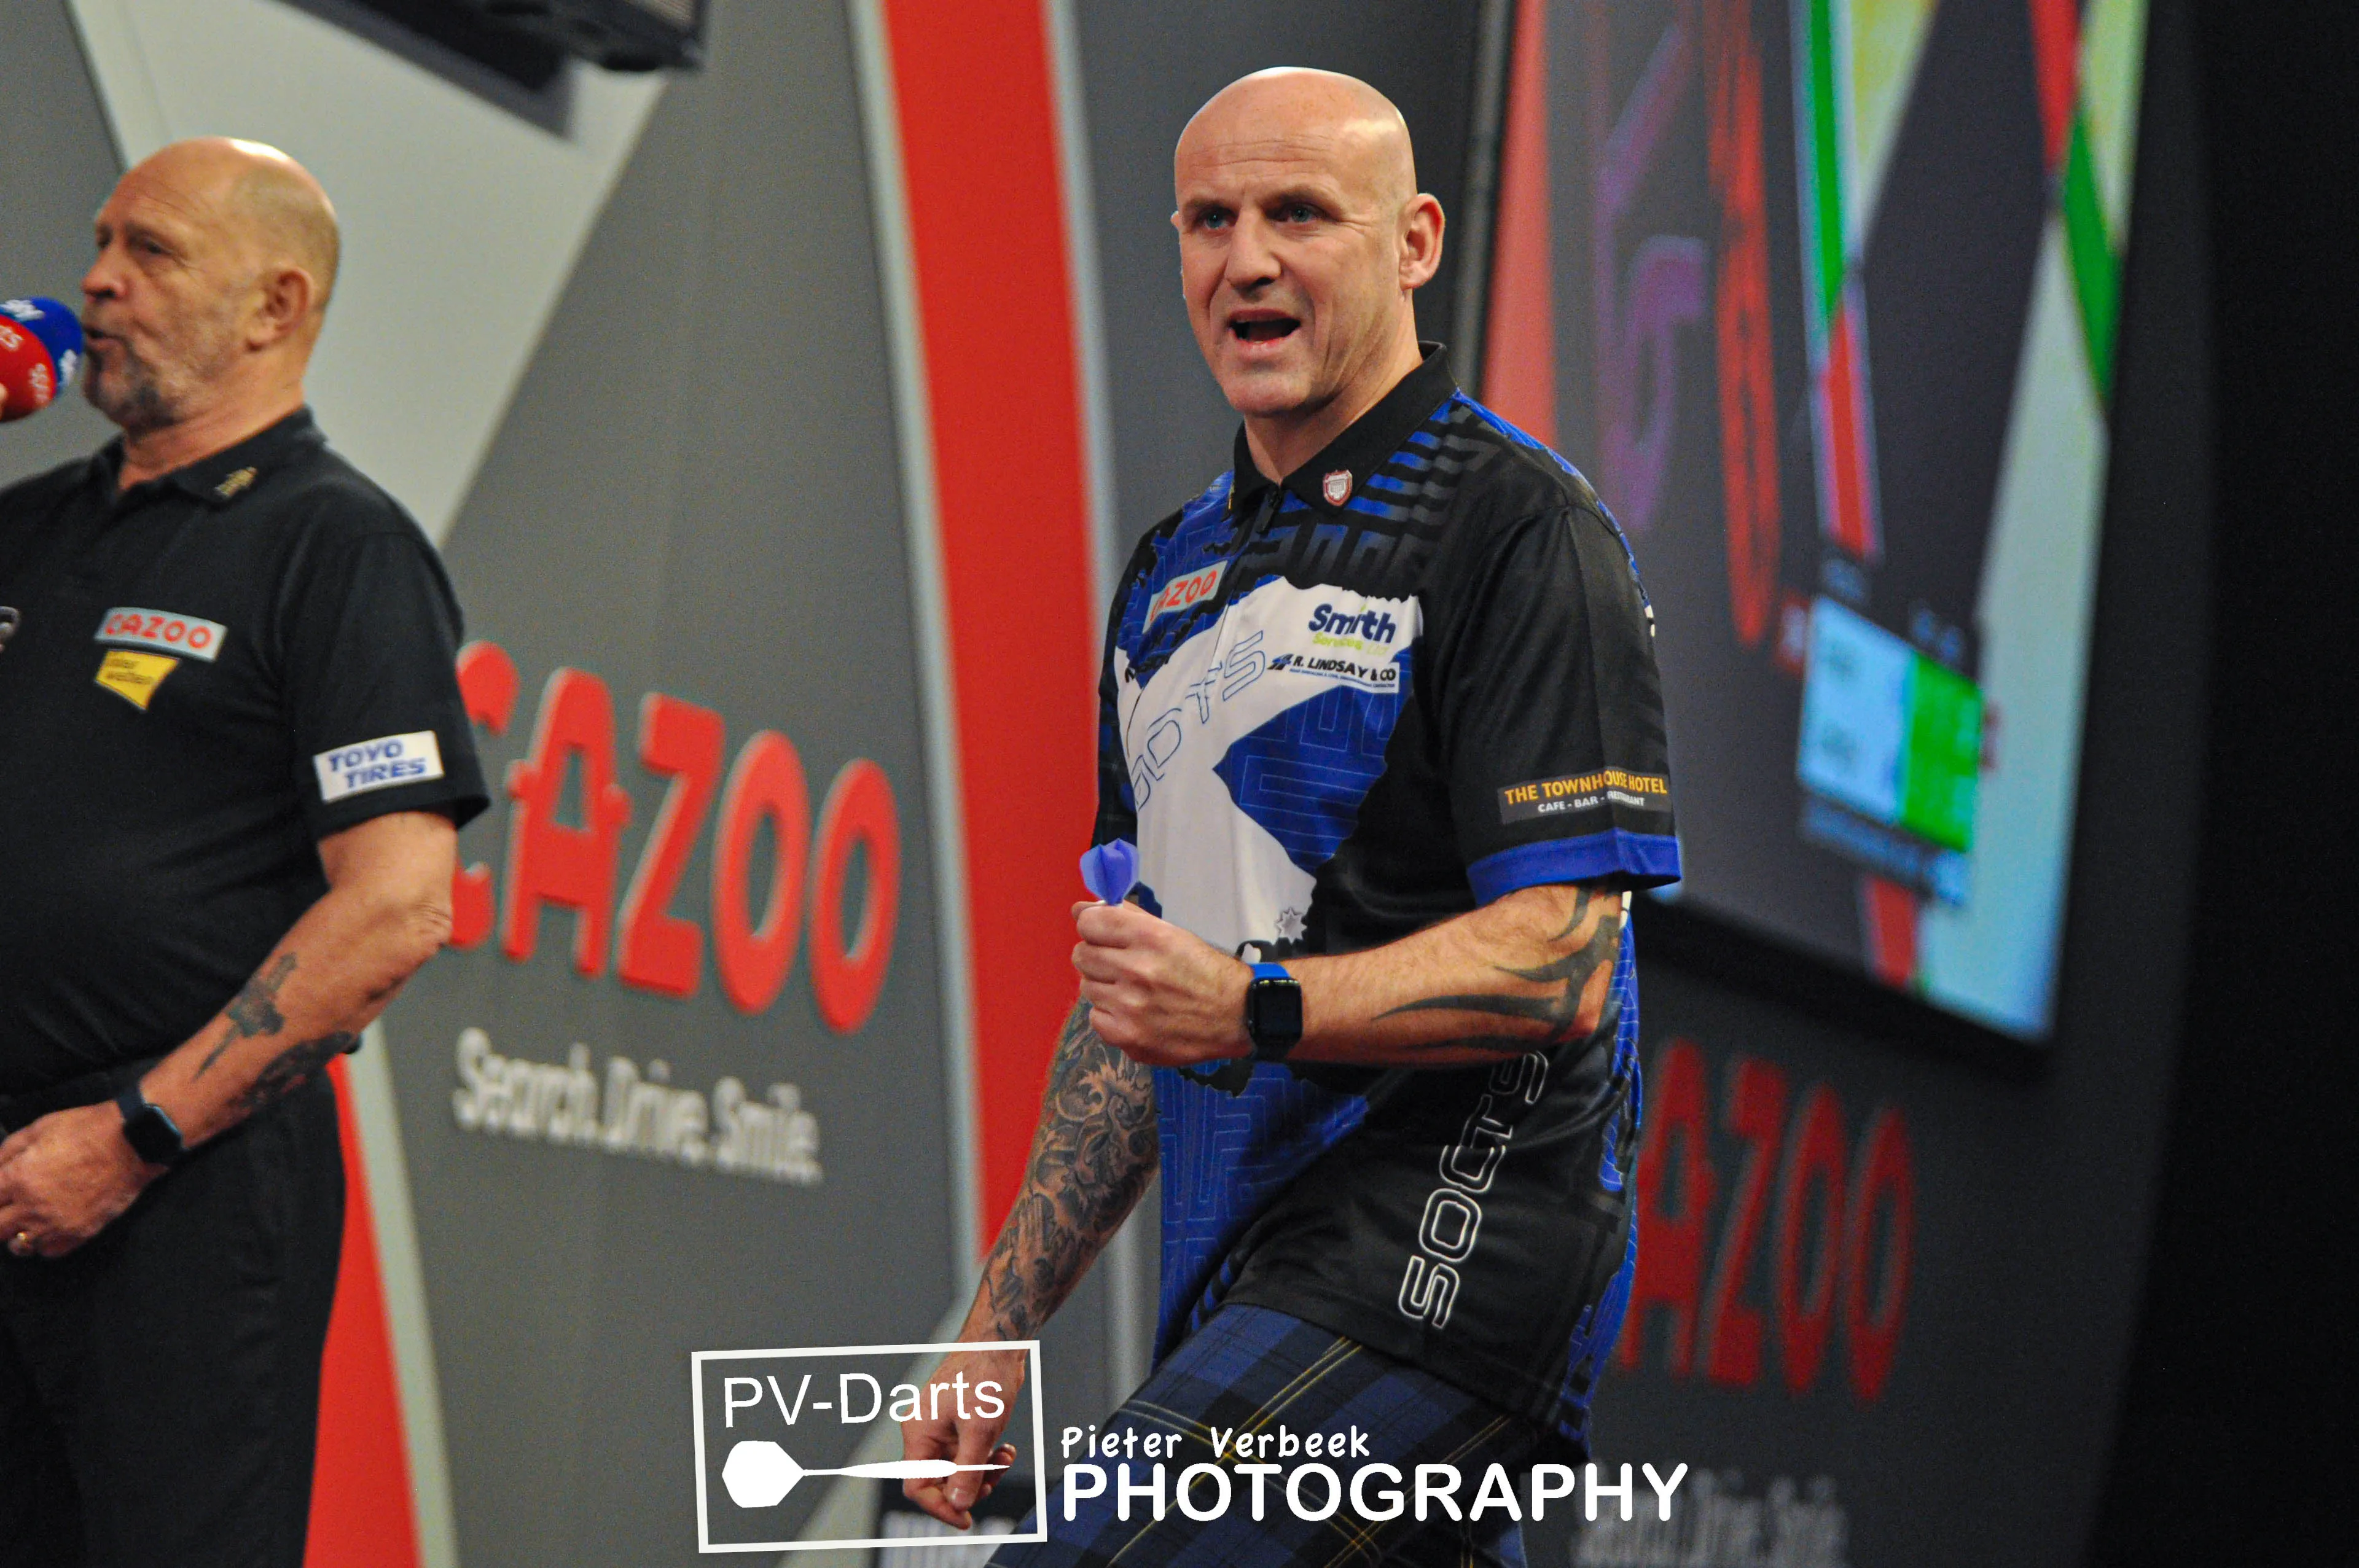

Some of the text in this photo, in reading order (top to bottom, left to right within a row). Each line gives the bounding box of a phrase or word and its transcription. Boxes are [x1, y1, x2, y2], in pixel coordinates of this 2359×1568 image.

[104, 613, 212, 649] CAZOO
[1309, 603, 1396, 644] Smith
[1293, 655, 1305, 667] R.
[1307, 657, 1369, 678] LINDSAY
[1380, 668, 1397, 682] CO
[329, 739, 404, 773] TOYO
[345, 757, 426, 788] TIRES
[1504, 770, 1668, 805] THE TOWNHOUSE HOTEL
[1538, 801, 1566, 813] CAFE
[1575, 796, 1599, 808] BAR
[1621, 1038, 1915, 1408] AZOO
